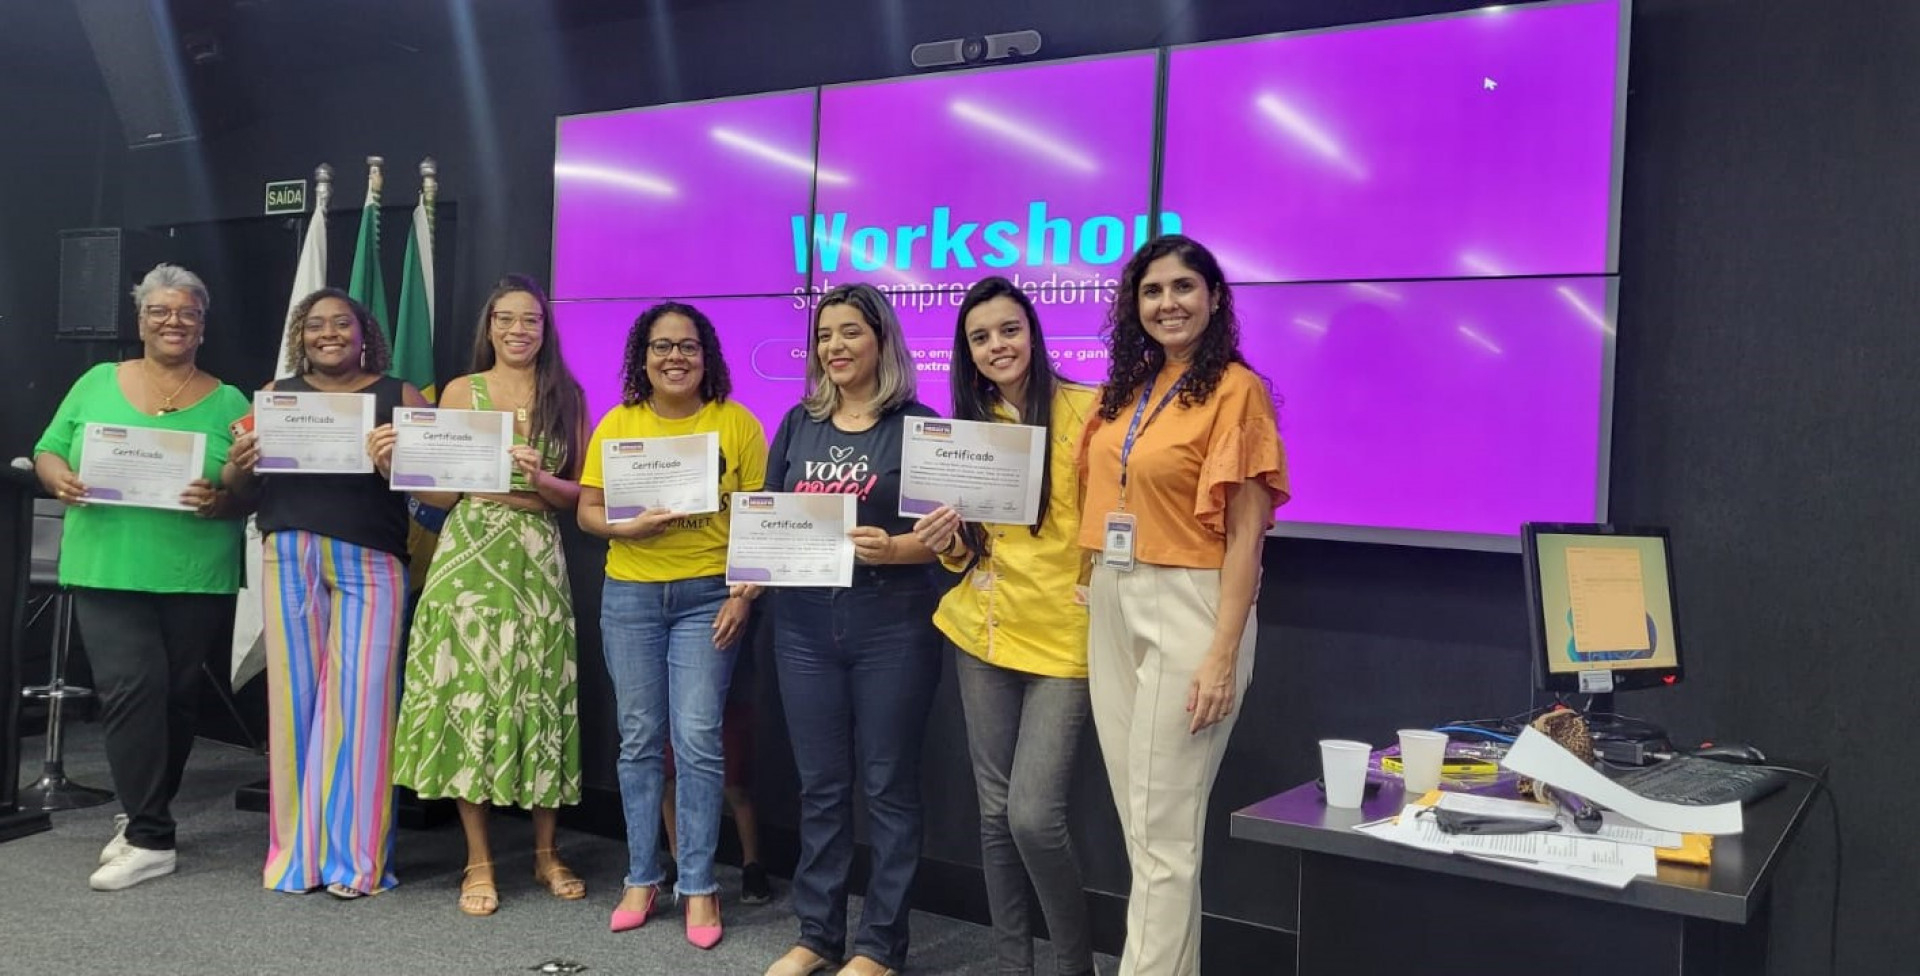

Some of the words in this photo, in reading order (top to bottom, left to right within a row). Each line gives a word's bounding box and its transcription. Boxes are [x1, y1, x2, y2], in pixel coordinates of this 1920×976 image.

[269, 186, 302, 205] SAÍDA
[790, 348, 807, 359] Co
[285, 414, 335, 424] Certificado
[423, 431, 473, 441] Certificado
[112, 447, 164, 459] Certificado
[936, 448, 994, 462] Certificado
[632, 459, 681, 470] Certificado
[805, 455, 869, 481] você
[760, 519, 814, 529] Certificado
